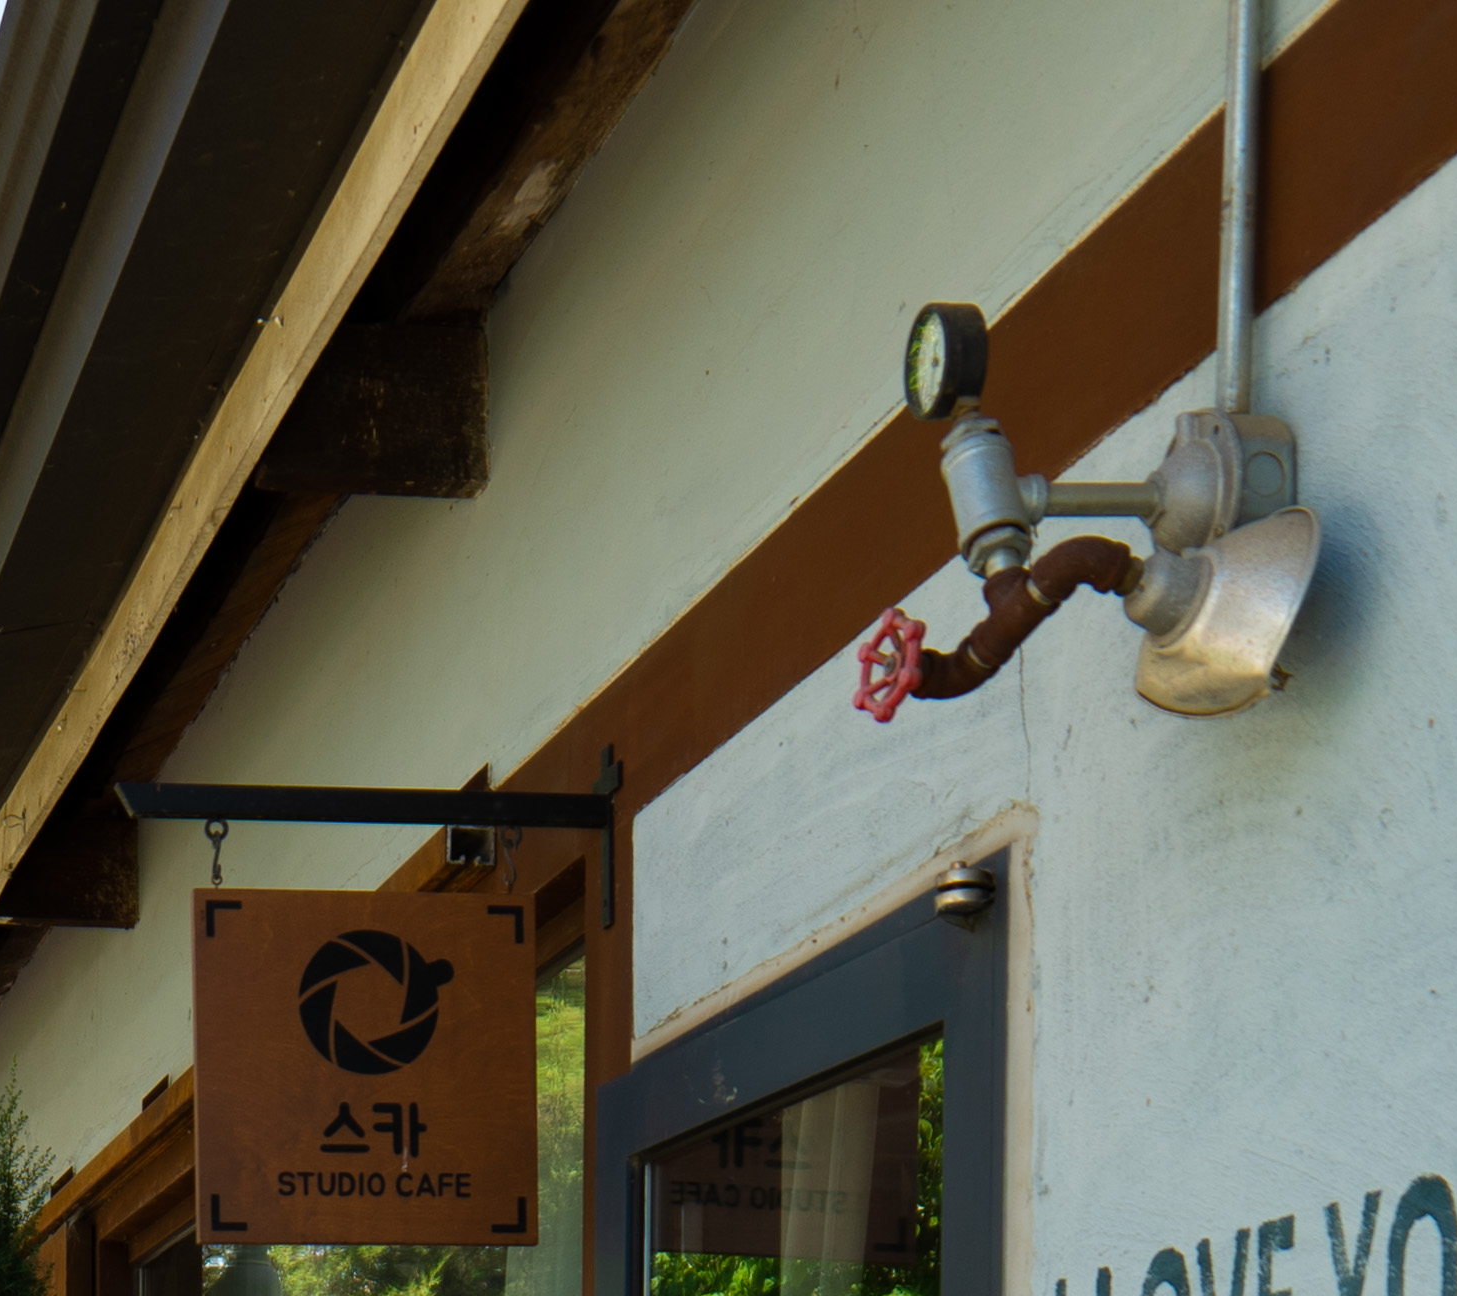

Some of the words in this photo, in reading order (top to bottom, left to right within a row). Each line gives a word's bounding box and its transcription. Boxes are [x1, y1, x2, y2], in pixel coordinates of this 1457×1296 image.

[320, 1102, 427, 1156] 스카
[278, 1172, 387, 1198] STUDIO
[396, 1173, 472, 1199] CAFE
